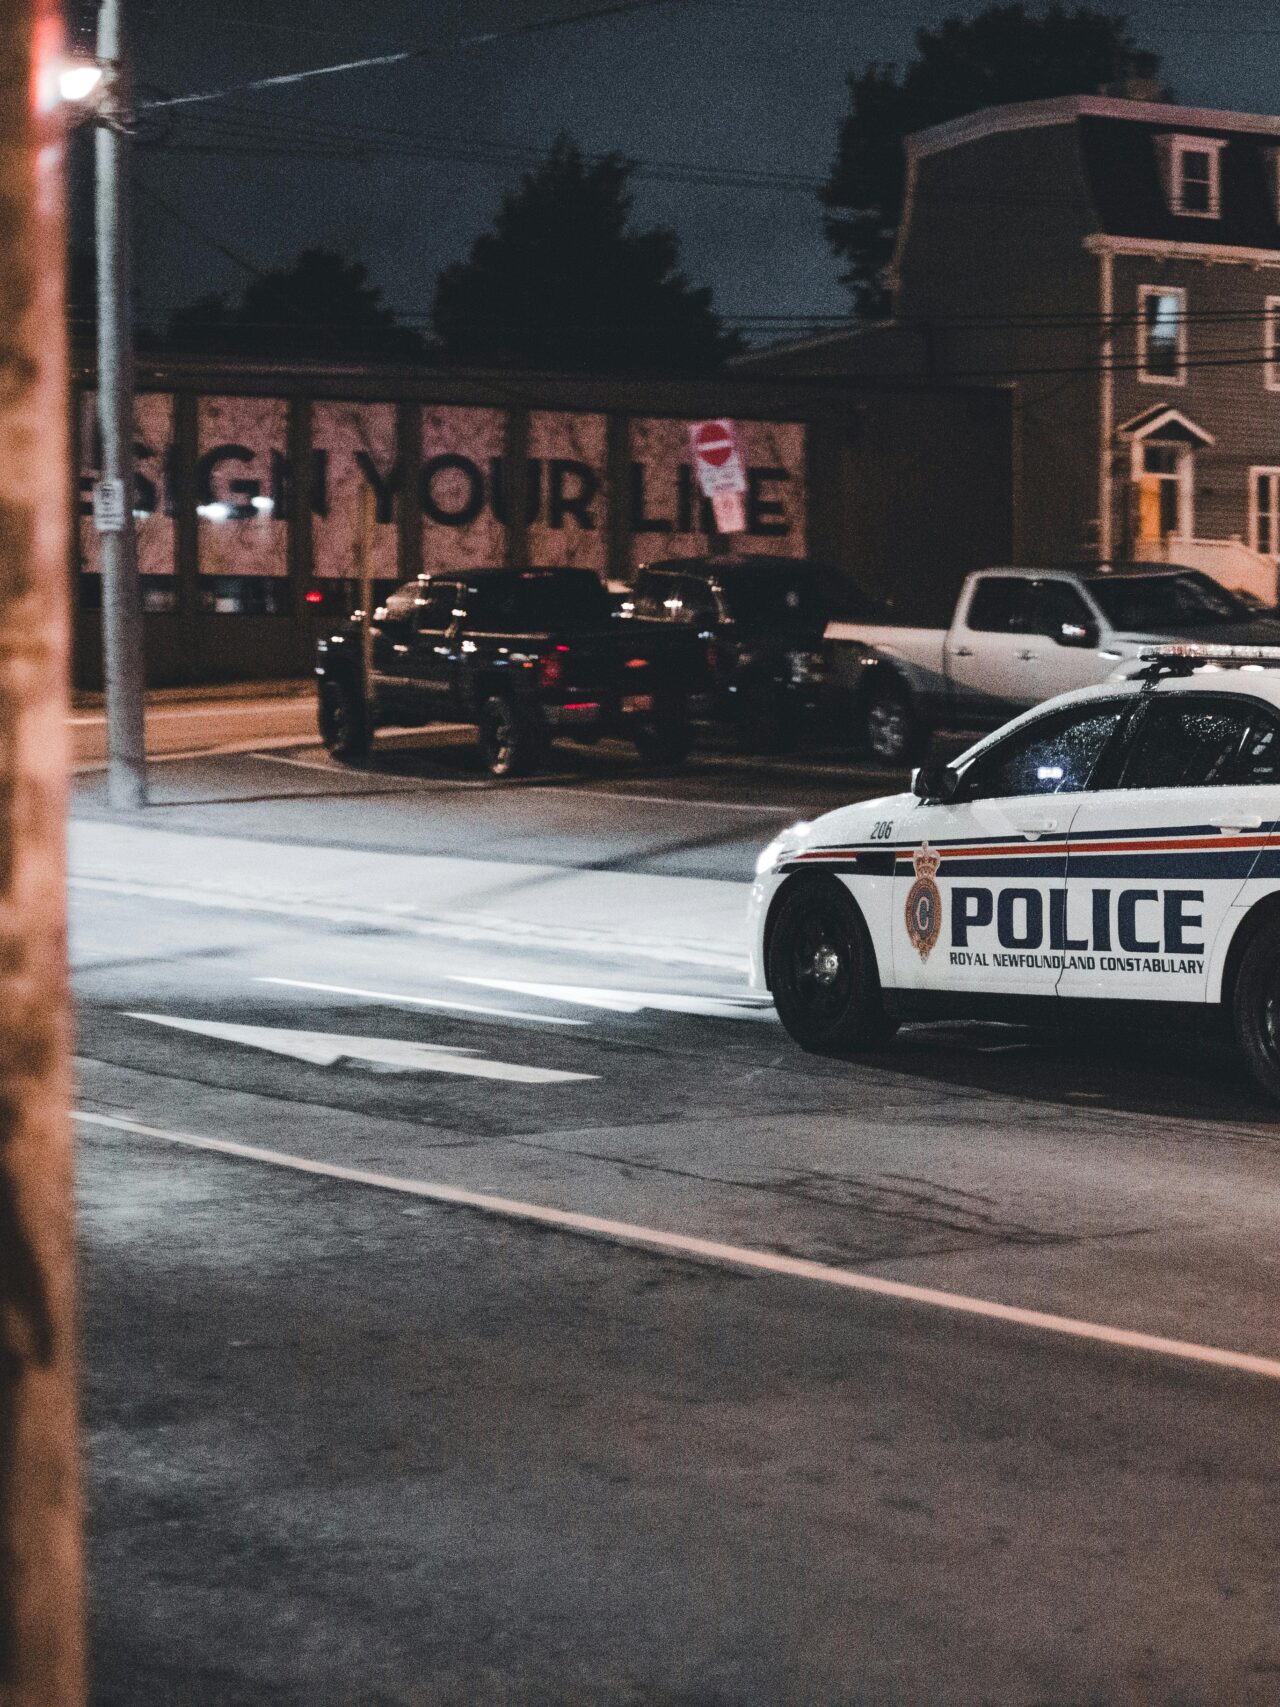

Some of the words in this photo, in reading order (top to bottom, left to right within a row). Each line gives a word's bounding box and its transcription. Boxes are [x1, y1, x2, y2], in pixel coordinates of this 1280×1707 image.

[355, 443, 599, 530] YOUR
[630, 461, 791, 536] LIE
[870, 820, 893, 839] 206
[951, 887, 1205, 954] POLICE
[950, 952, 989, 967] ROYAL
[993, 953, 1095, 970] NEWFOUNDLAND
[1100, 957, 1204, 974] CONSTABULARY
